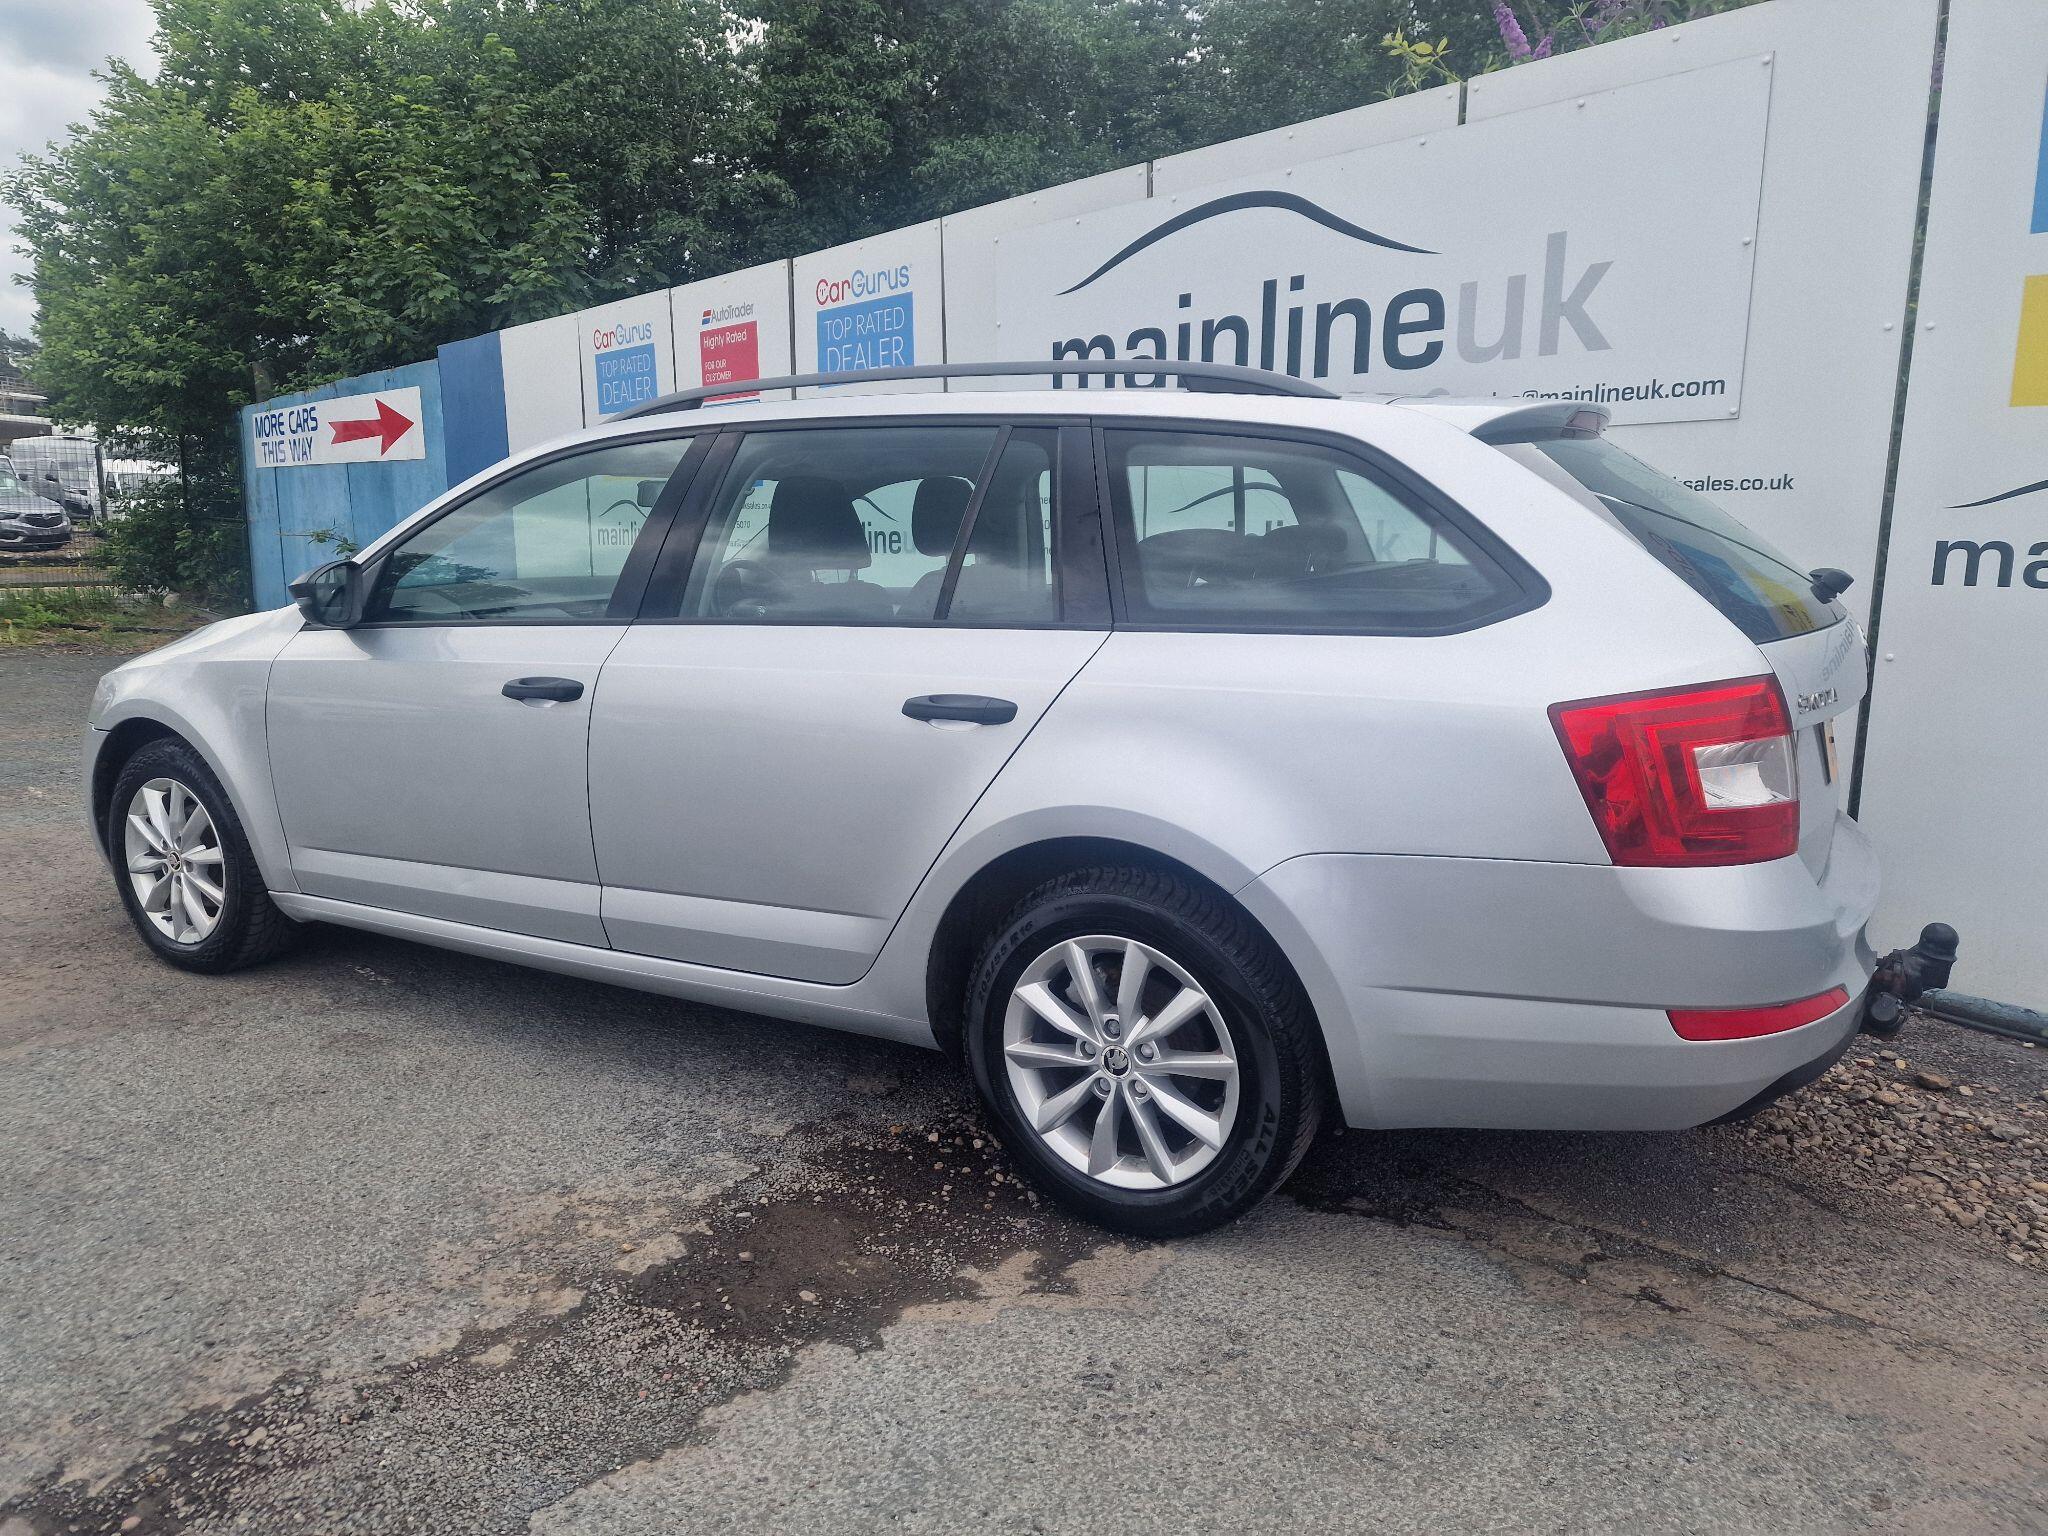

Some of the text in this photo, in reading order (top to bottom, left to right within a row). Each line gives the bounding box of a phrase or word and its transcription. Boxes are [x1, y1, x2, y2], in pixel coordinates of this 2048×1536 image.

[816, 265, 910, 305] CarGurus
[711, 302, 754, 323] AutoTrader
[824, 306, 905, 341] TOP RATED
[593, 322, 653, 350] CarGurus
[704, 329, 747, 349] Highly Rated
[600, 353, 650, 378] TOP RATED
[716, 359, 727, 369] OUR
[827, 336, 905, 373] DEALER
[706, 371, 732, 382] CUSTOMER
[603, 376, 653, 405] DEALER
[254, 406, 318, 438] MORE CARS
[261, 436, 313, 463] THIS WAY
[1673, 474, 1794, 491] sales.co.uk
